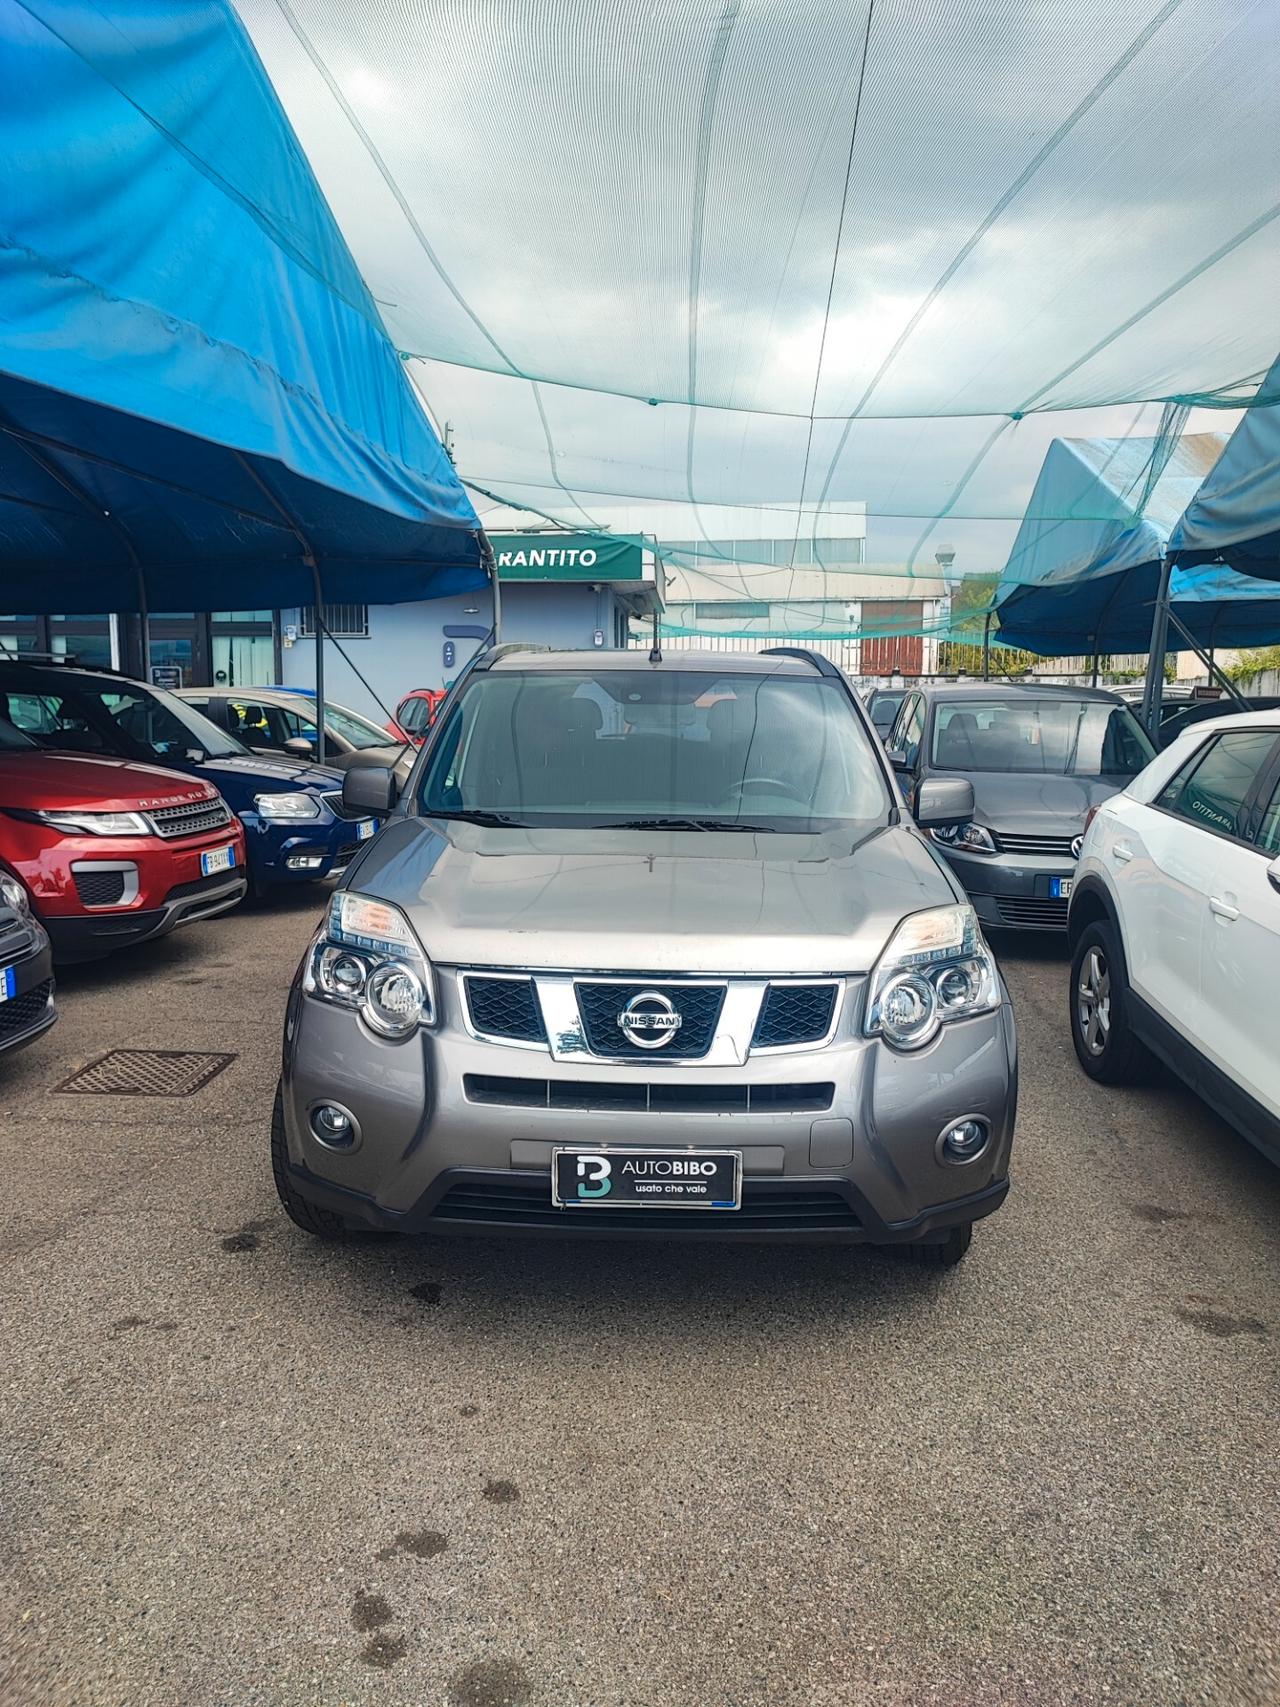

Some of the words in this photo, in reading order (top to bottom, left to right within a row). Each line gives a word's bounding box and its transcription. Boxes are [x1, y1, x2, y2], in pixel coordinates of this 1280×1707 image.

[623, 1015, 676, 1027] NISSAN
[621, 1160, 718, 1176] AUTOBIBO
[635, 1184, 663, 1193] usato
[664, 1184, 684, 1194] che
[685, 1185, 708, 1194] vale
